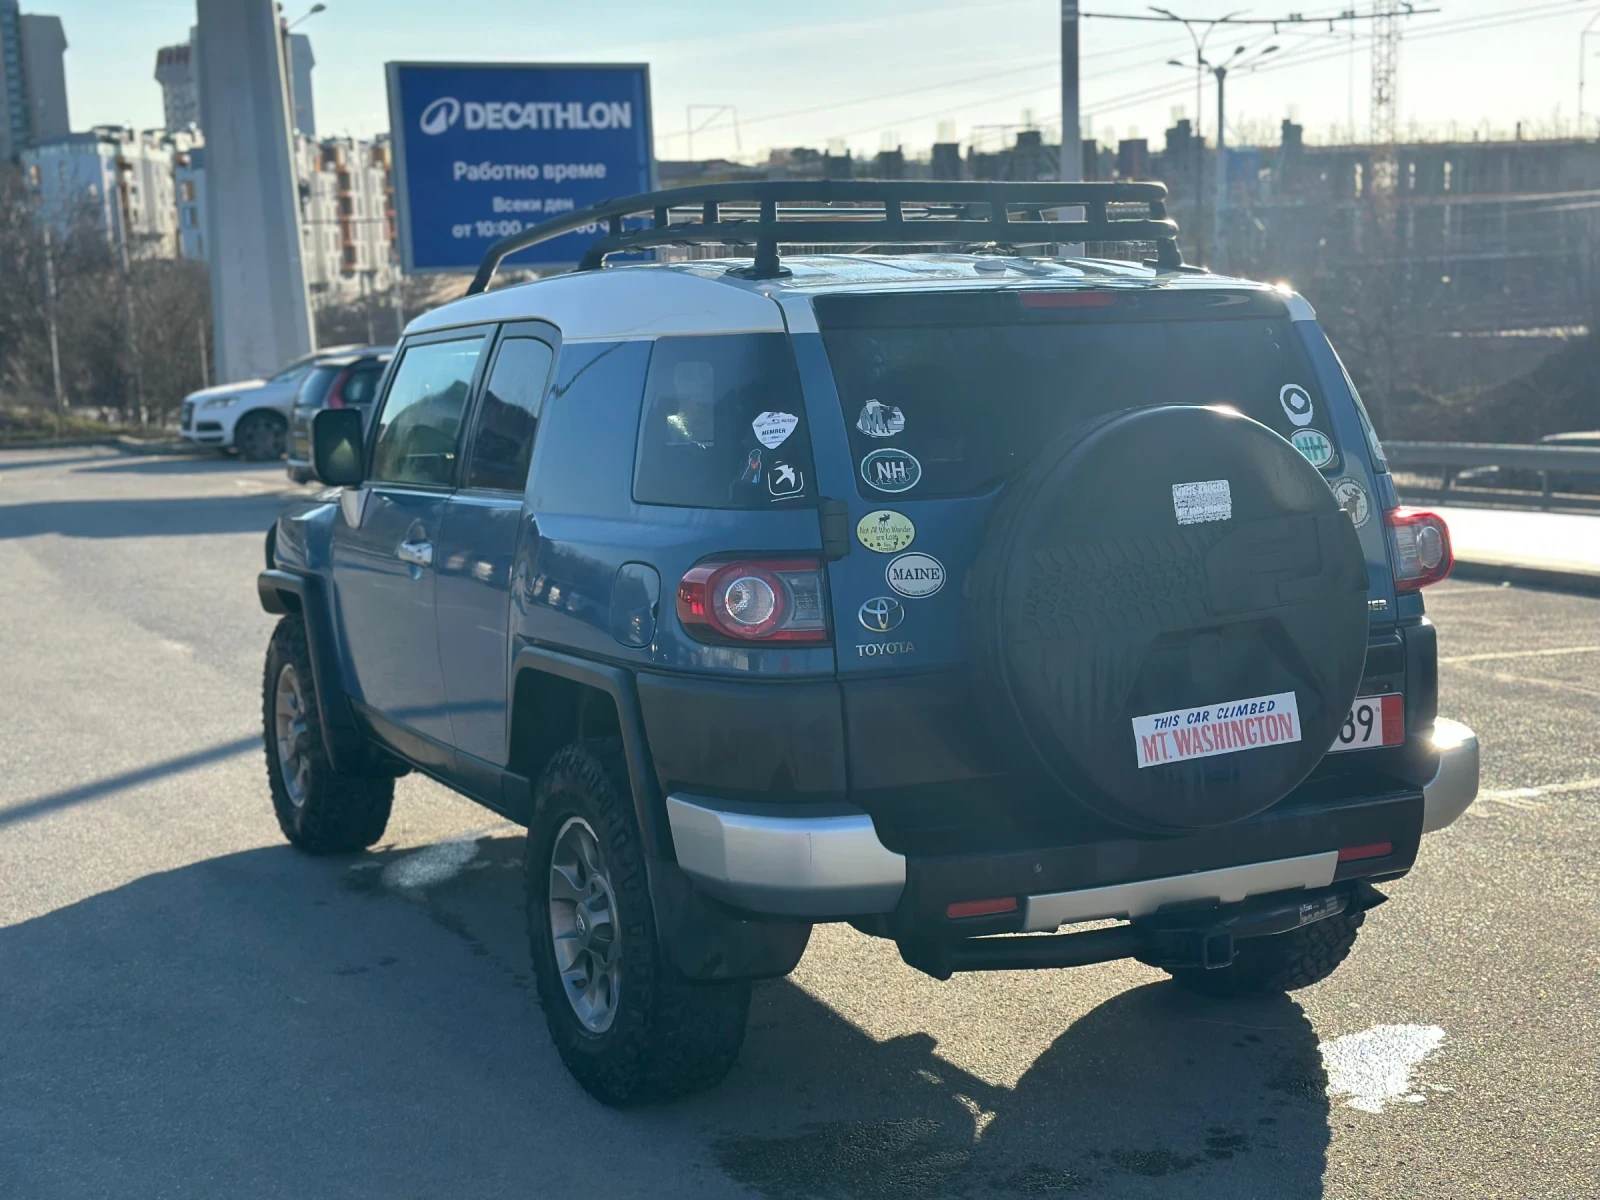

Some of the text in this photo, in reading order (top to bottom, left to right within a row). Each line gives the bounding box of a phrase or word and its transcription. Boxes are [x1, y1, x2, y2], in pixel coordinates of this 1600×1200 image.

[463, 102, 632, 131] DECATHLON
[454, 161, 607, 183] Работно време
[492, 196, 575, 214] Всеки ден
[451, 224, 472, 238] от
[475, 220, 523, 238] 10:00
[761, 428, 787, 436] MEMBER
[1294, 435, 1328, 461] NH
[876, 461, 906, 479] NH
[879, 525, 890, 534] Who
[892, 567, 940, 581] MAINE
[856, 641, 915, 657] TOYOTA
[1154, 700, 1276, 730] THIS CAR CLIMBED
[1141, 712, 1294, 763] MT. WASHINGTON
